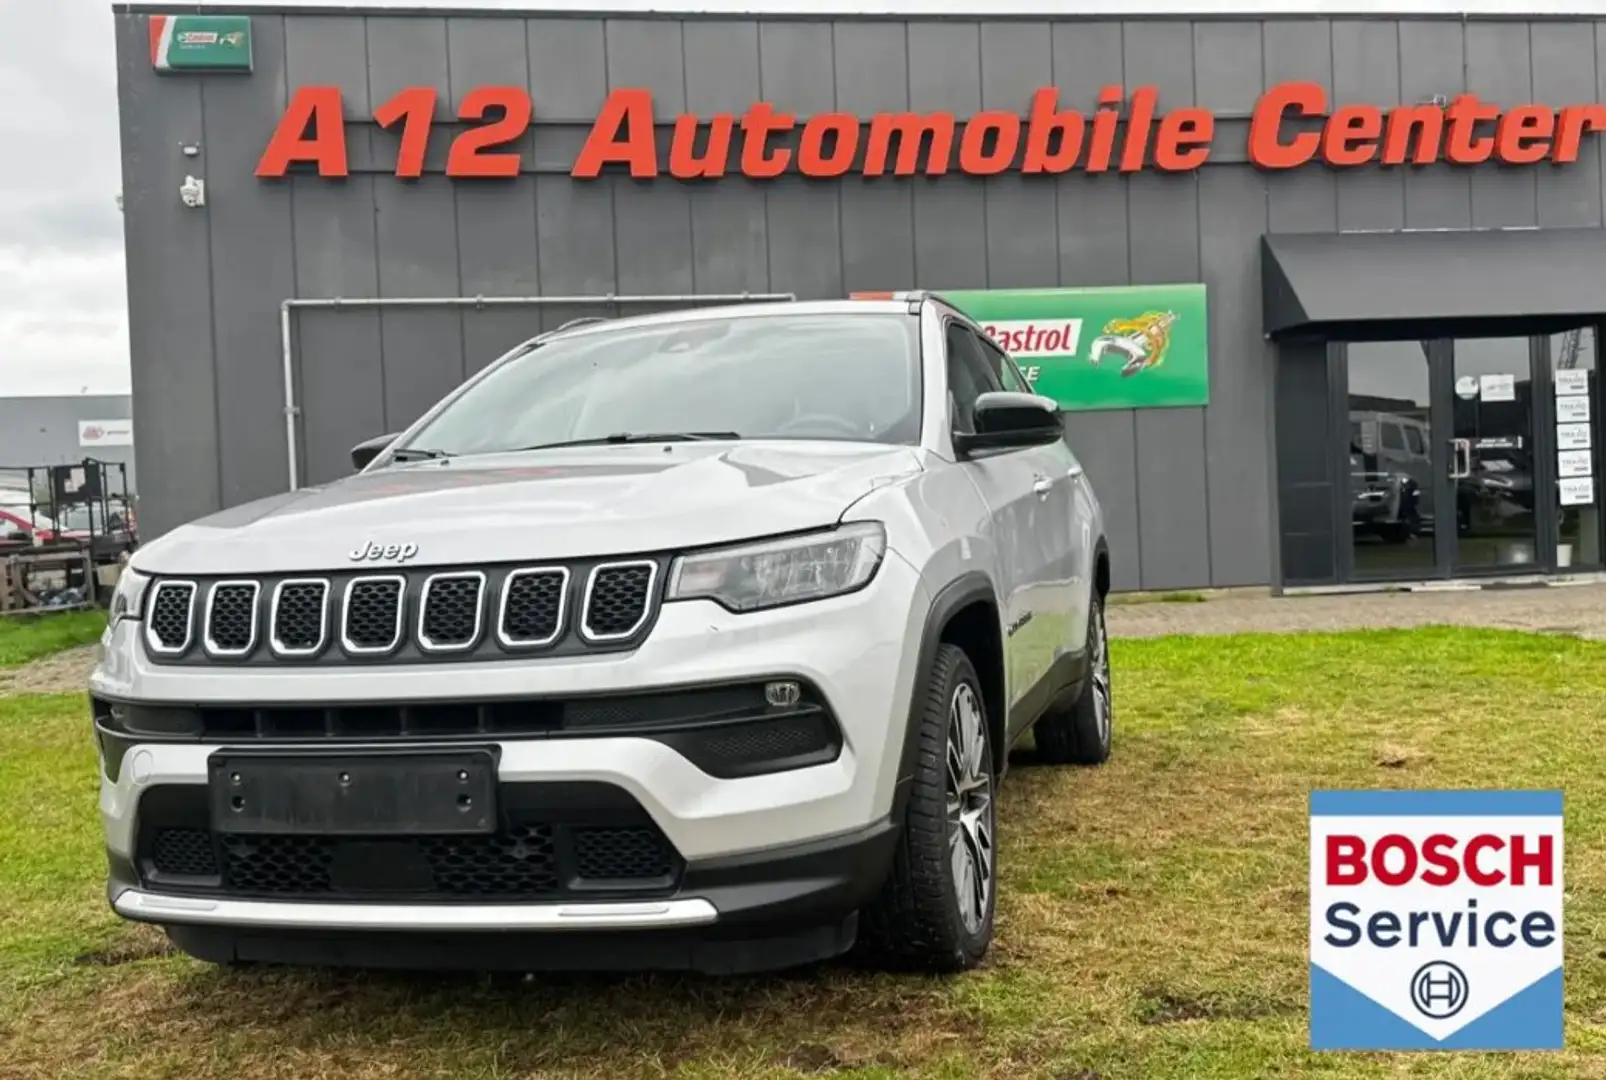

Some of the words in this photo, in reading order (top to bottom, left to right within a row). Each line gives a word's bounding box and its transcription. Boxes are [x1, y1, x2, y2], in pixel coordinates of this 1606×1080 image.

[255, 85, 532, 178] A12
[572, 85, 1214, 178] Automobile
[1249, 81, 1606, 168] Center
[348, 540, 419, 563] Jeep
